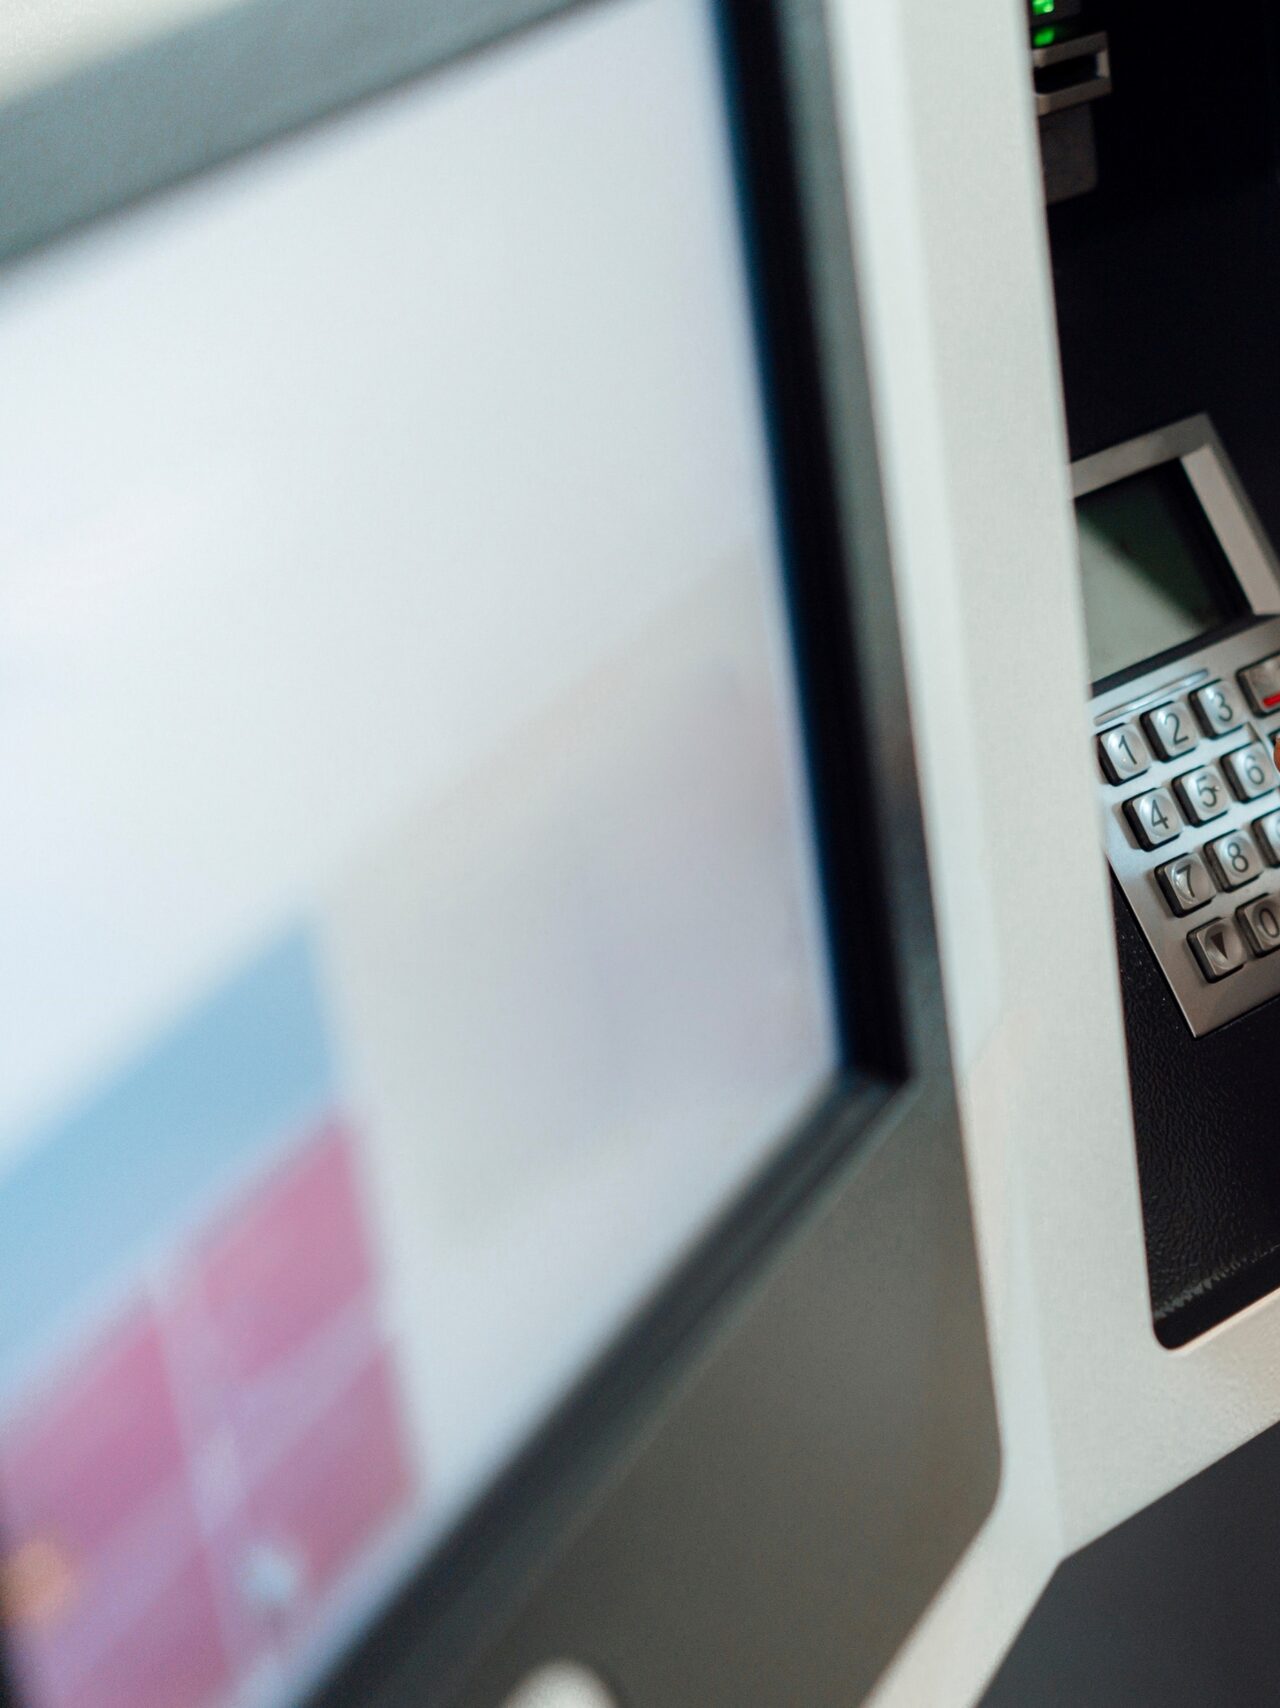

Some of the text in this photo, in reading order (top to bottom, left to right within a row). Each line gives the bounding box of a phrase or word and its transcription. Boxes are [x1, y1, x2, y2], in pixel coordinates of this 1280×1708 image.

[1118, 692, 1233, 765] 1 2 3
[1151, 754, 1265, 829] 4 5 6
[1176, 864, 1196, 898] 7
[1227, 842, 1249, 873] 8
[1258, 907, 1280, 939] 0
